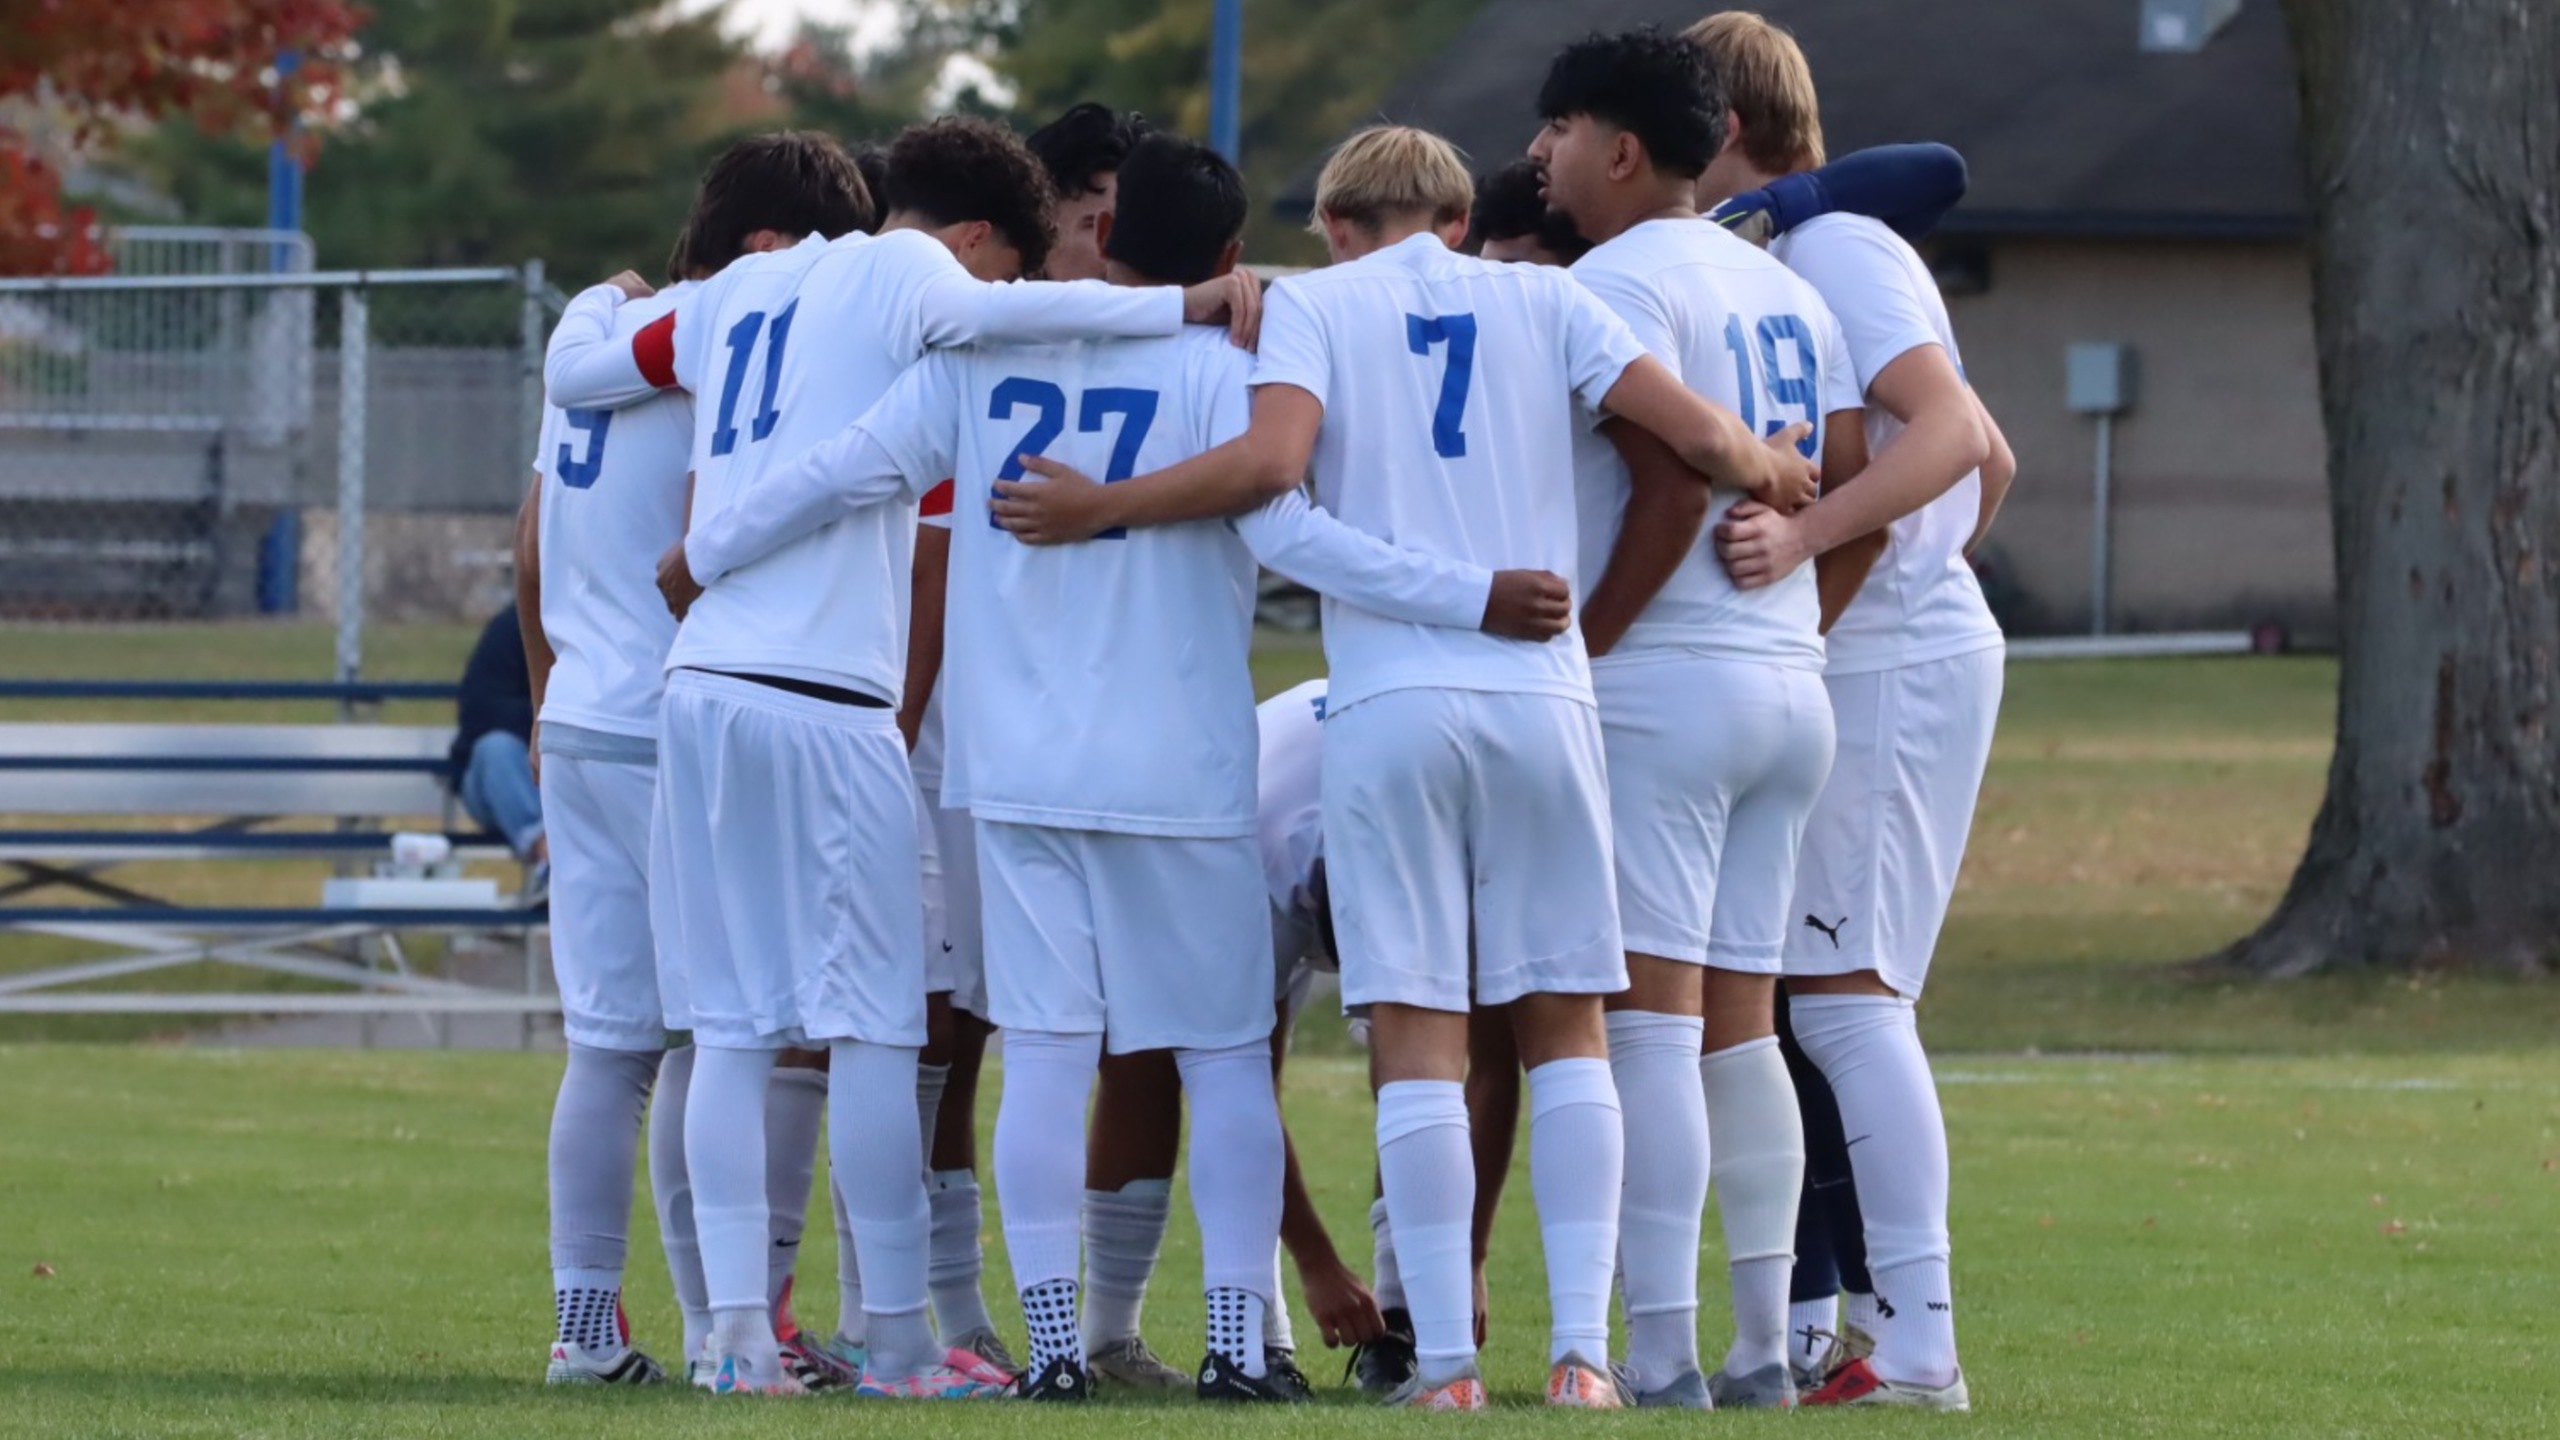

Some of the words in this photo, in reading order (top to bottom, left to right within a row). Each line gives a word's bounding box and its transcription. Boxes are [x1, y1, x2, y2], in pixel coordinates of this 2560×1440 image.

[711, 296, 799, 457] 11
[1406, 313, 1476, 457] 7
[1724, 313, 1818, 459] 19
[988, 376, 1159, 540] 27
